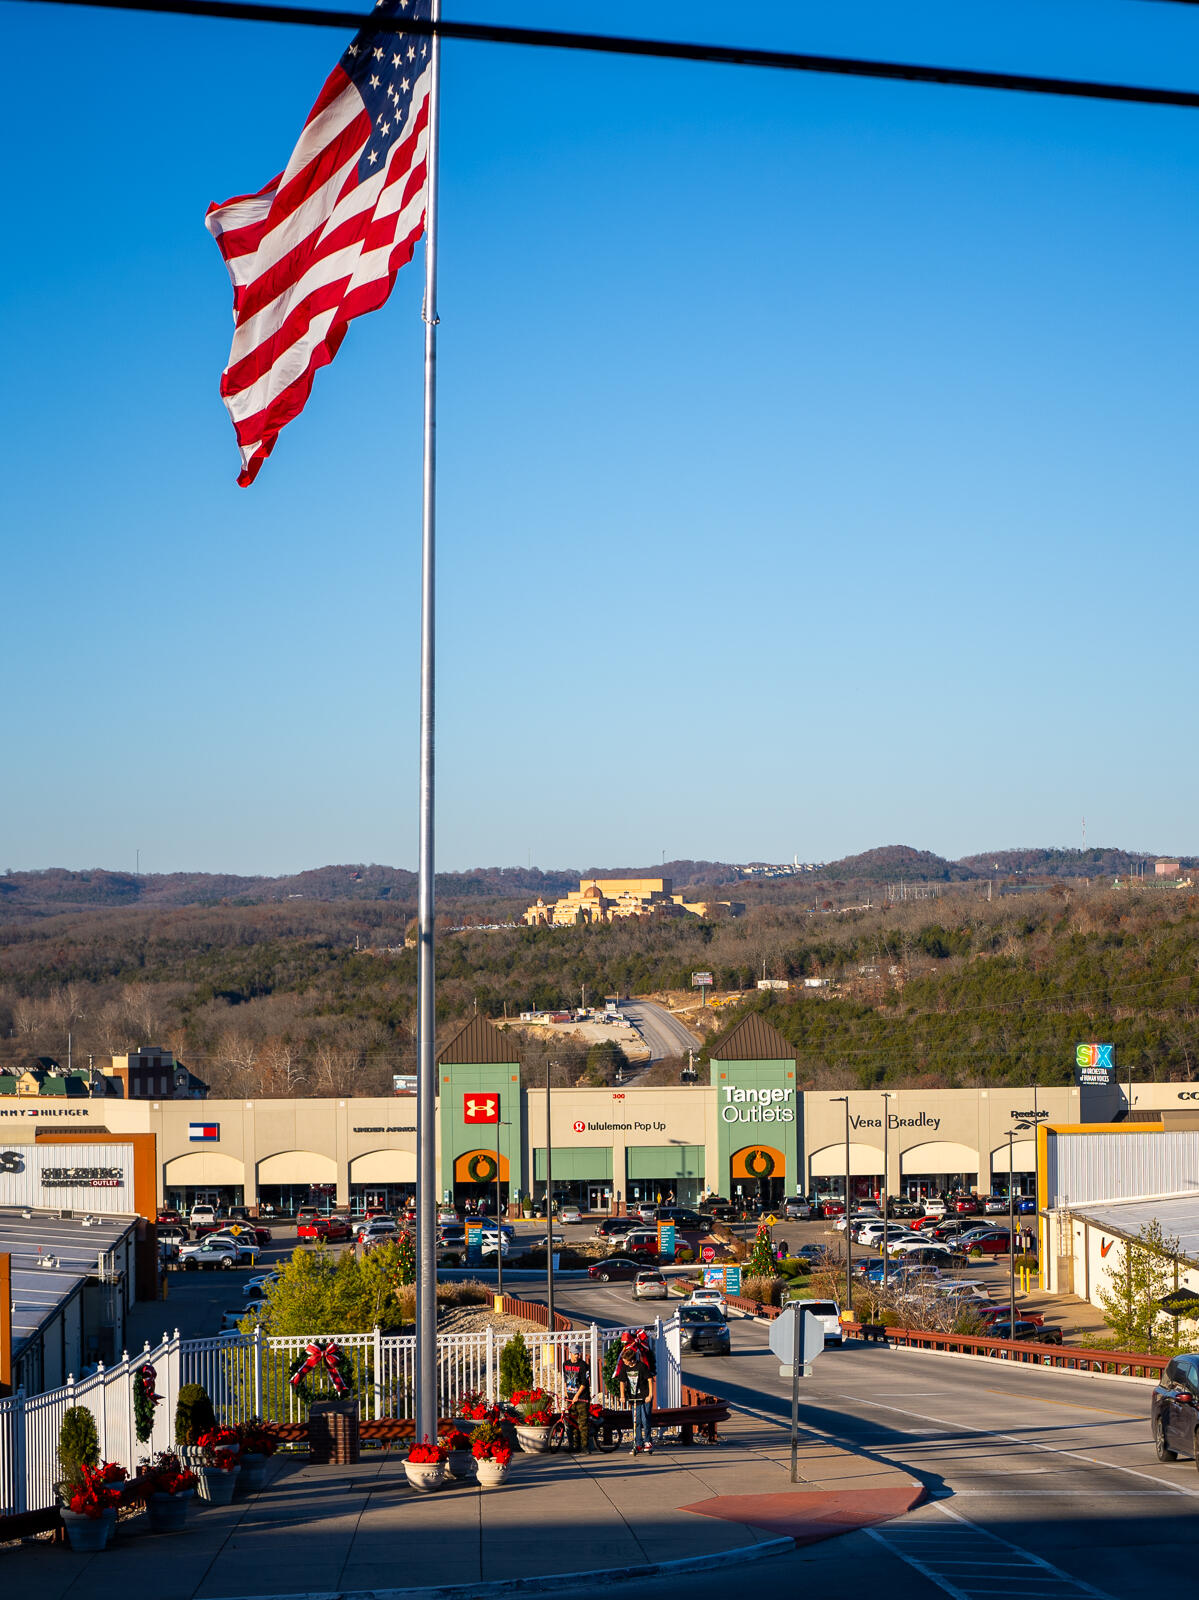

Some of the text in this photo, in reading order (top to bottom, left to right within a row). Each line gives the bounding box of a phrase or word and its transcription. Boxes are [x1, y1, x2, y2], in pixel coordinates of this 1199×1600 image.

[1076, 1043, 1113, 1068] SIX
[722, 1085, 794, 1107] Tanger
[40, 1109, 89, 1117] HILFIGER
[722, 1105, 795, 1123] Outlets
[1010, 1110, 1050, 1119] Reebok
[587, 1121, 667, 1132] lululemon Pop Up
